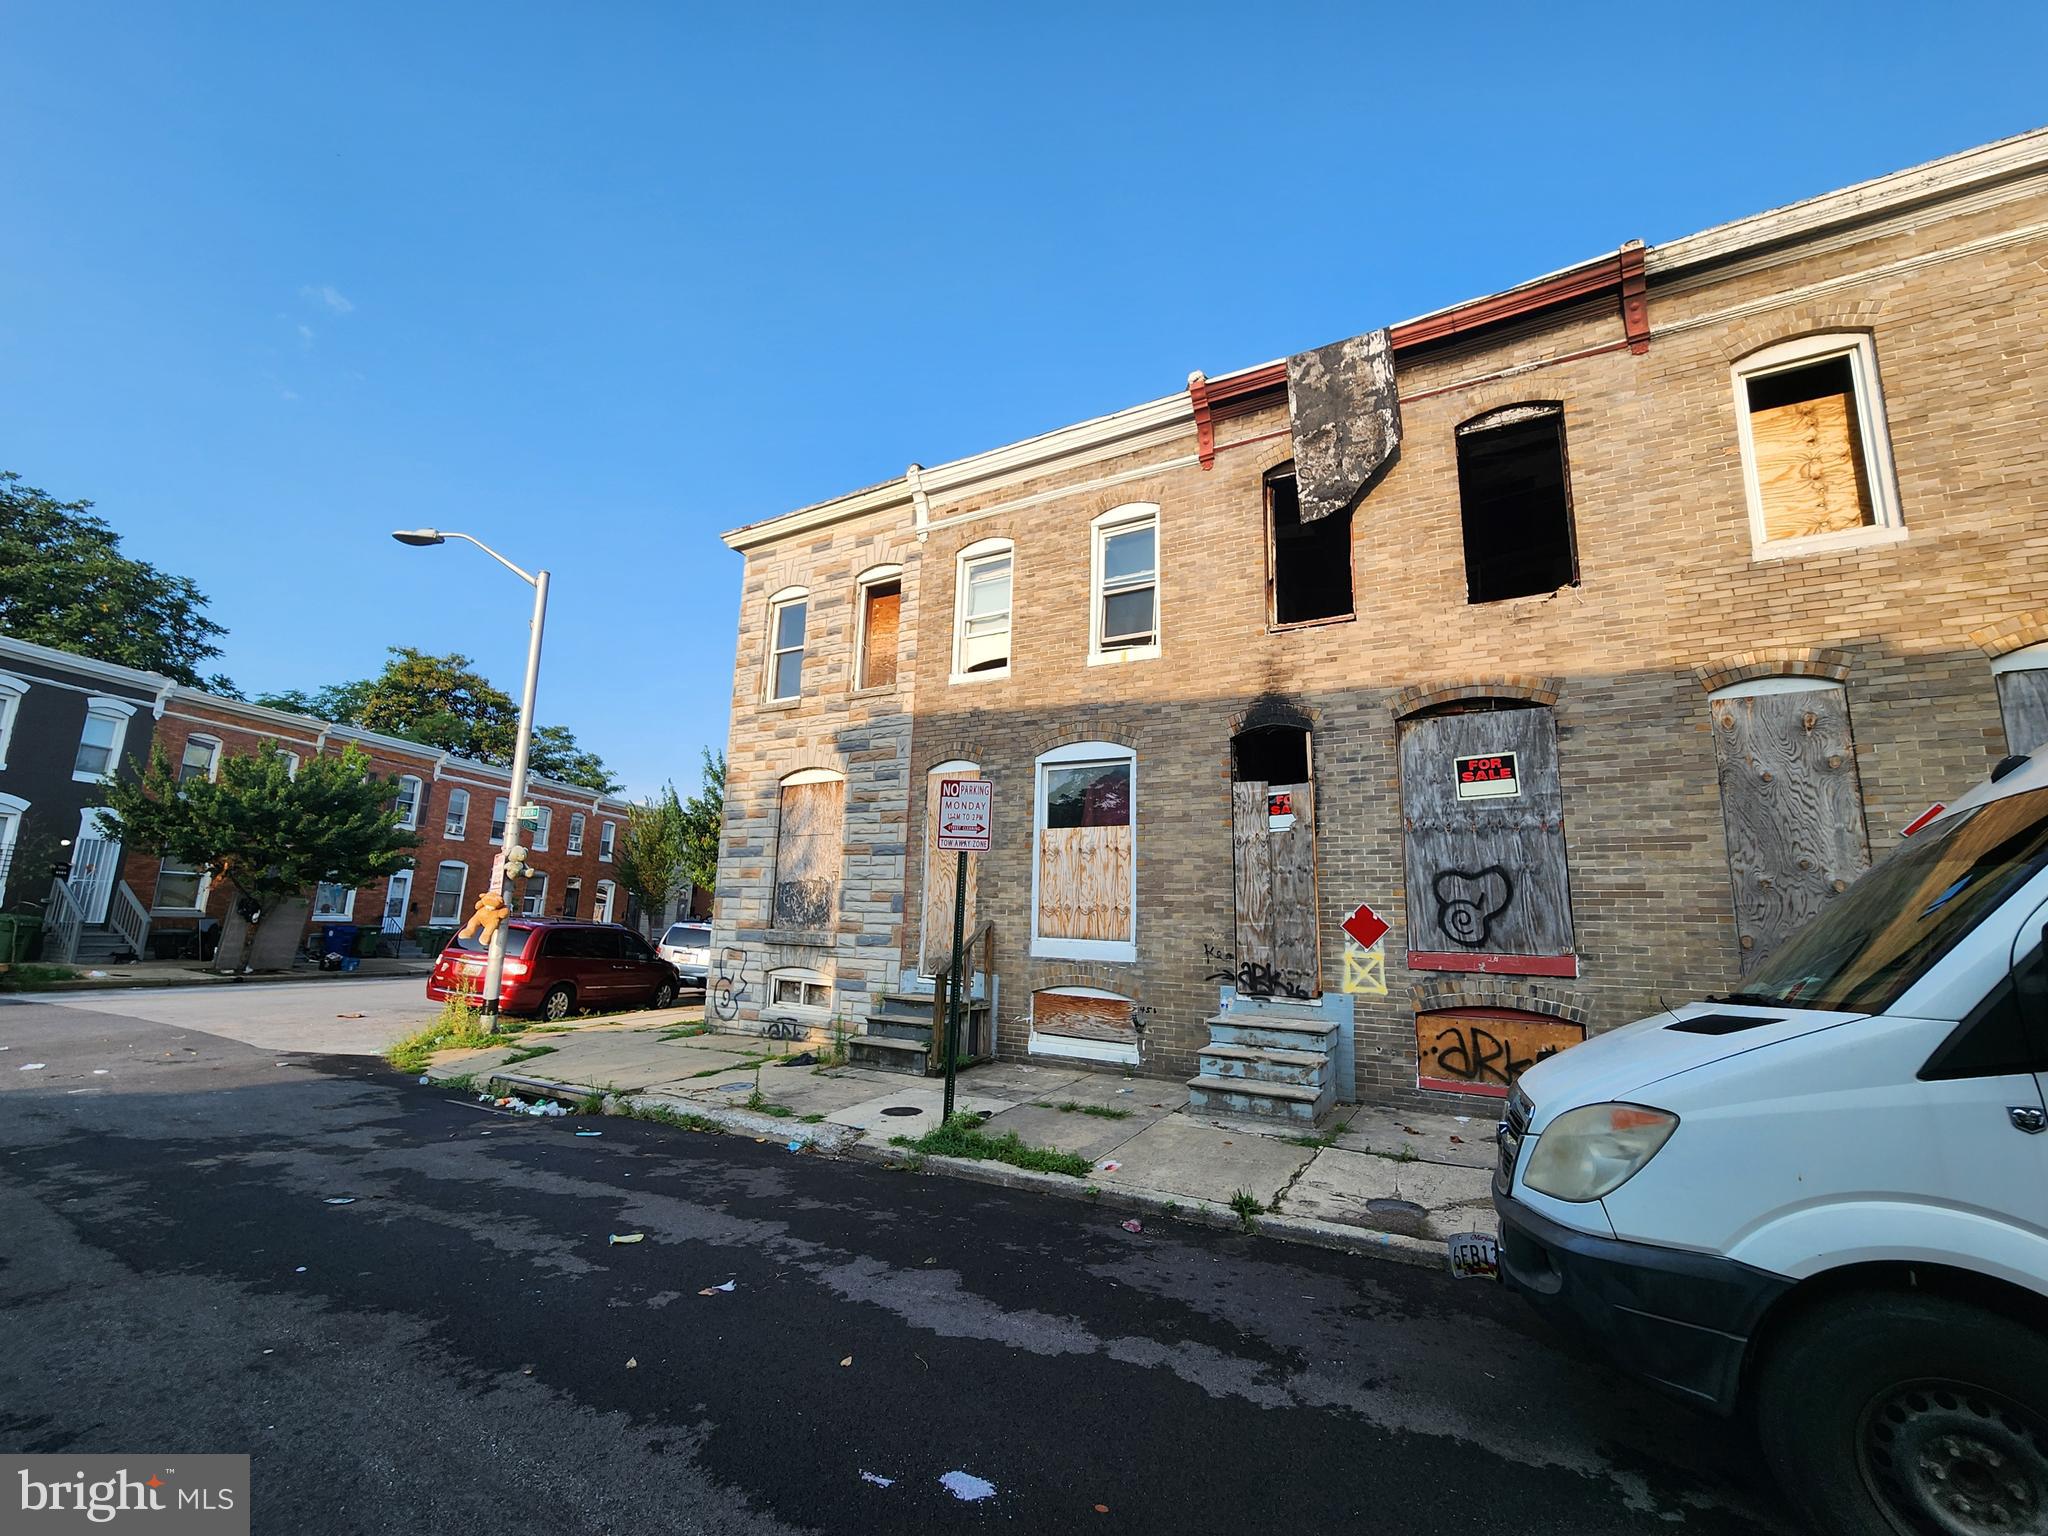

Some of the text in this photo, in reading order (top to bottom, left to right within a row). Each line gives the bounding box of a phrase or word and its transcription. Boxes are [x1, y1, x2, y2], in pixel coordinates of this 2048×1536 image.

[1468, 758, 1502, 770] FOR
[1462, 768, 1512, 781] SALE
[943, 783, 990, 797] NO PARKING
[1275, 795, 1291, 804] FO
[945, 801, 986, 810] MONDAY
[955, 840, 971, 848] AWAY
